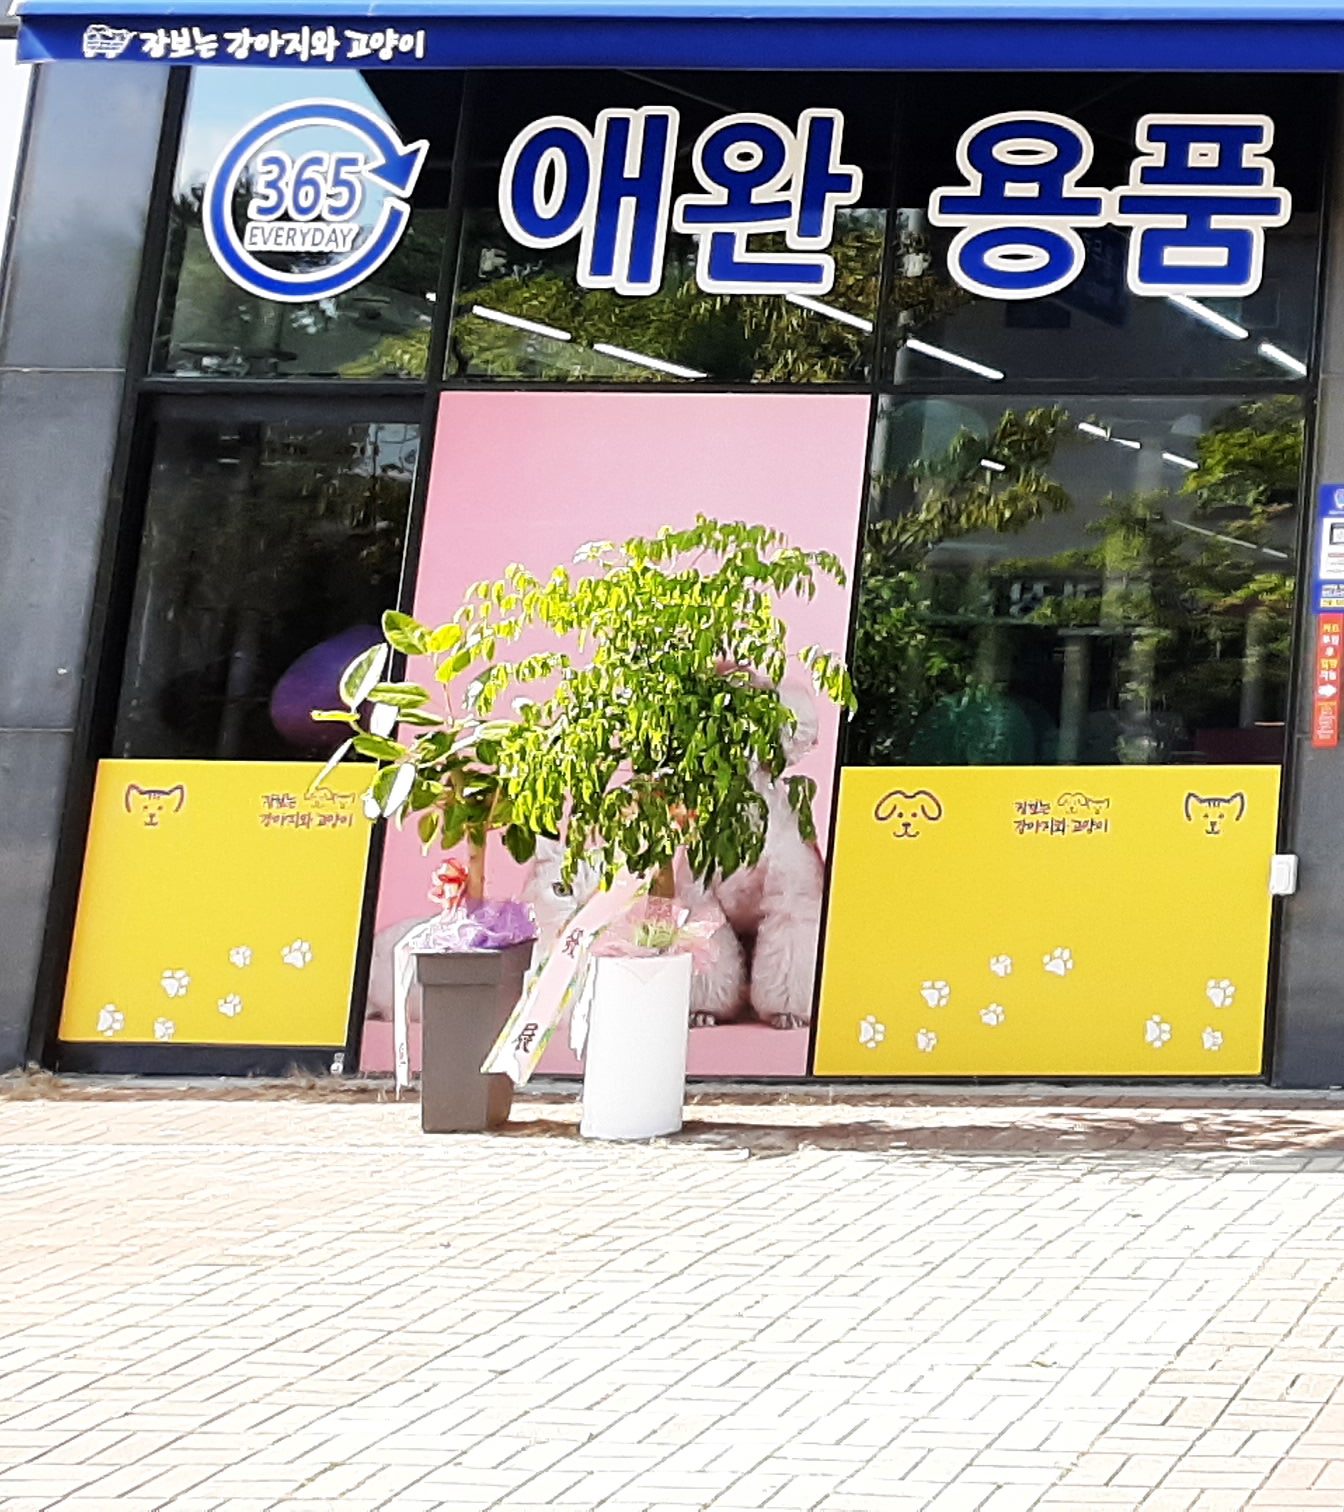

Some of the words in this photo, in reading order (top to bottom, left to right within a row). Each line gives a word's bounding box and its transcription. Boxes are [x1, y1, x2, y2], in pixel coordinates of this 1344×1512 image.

[140, 28, 219, 59] 장보는
[223, 26, 341, 62] 강아지와
[344, 29, 425, 61] 고양이
[248, 151, 365, 222] 365
[499, 106, 862, 296] 애완
[928, 110, 1291, 299] 용품
[244, 223, 359, 252] EVERYDAY
